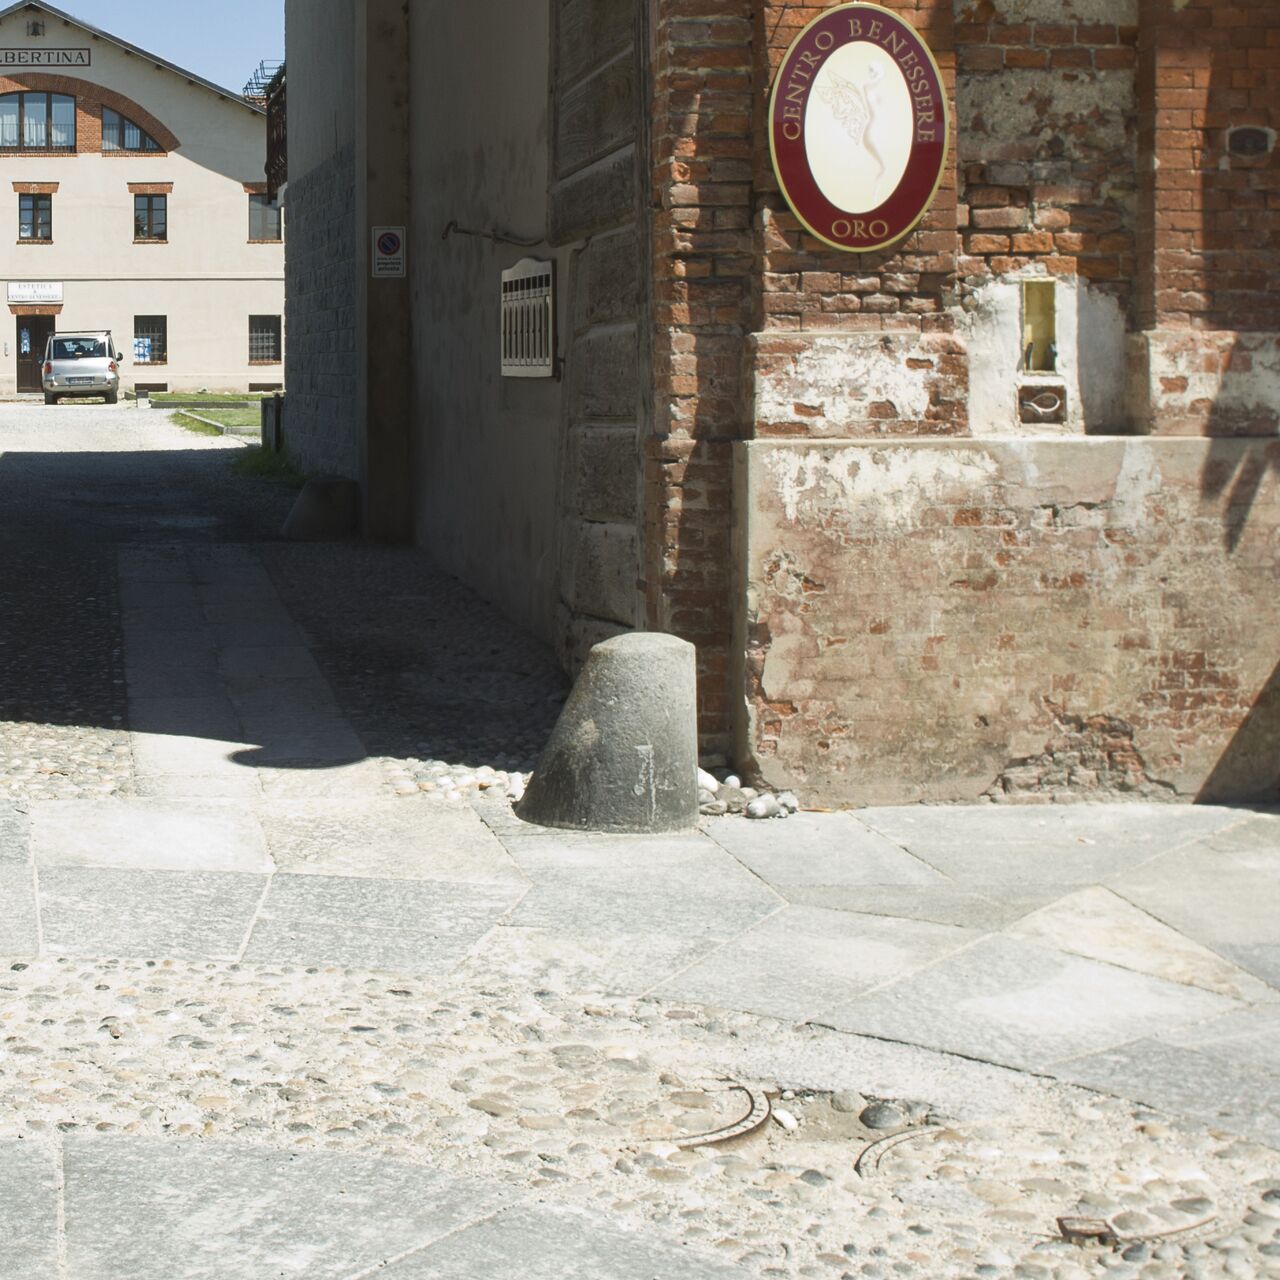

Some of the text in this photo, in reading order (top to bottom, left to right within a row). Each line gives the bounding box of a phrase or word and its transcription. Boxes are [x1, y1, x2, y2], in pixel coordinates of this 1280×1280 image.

[783, 18, 936, 142] CENTRO BENESSERE
[831, 219, 888, 239] ORO
